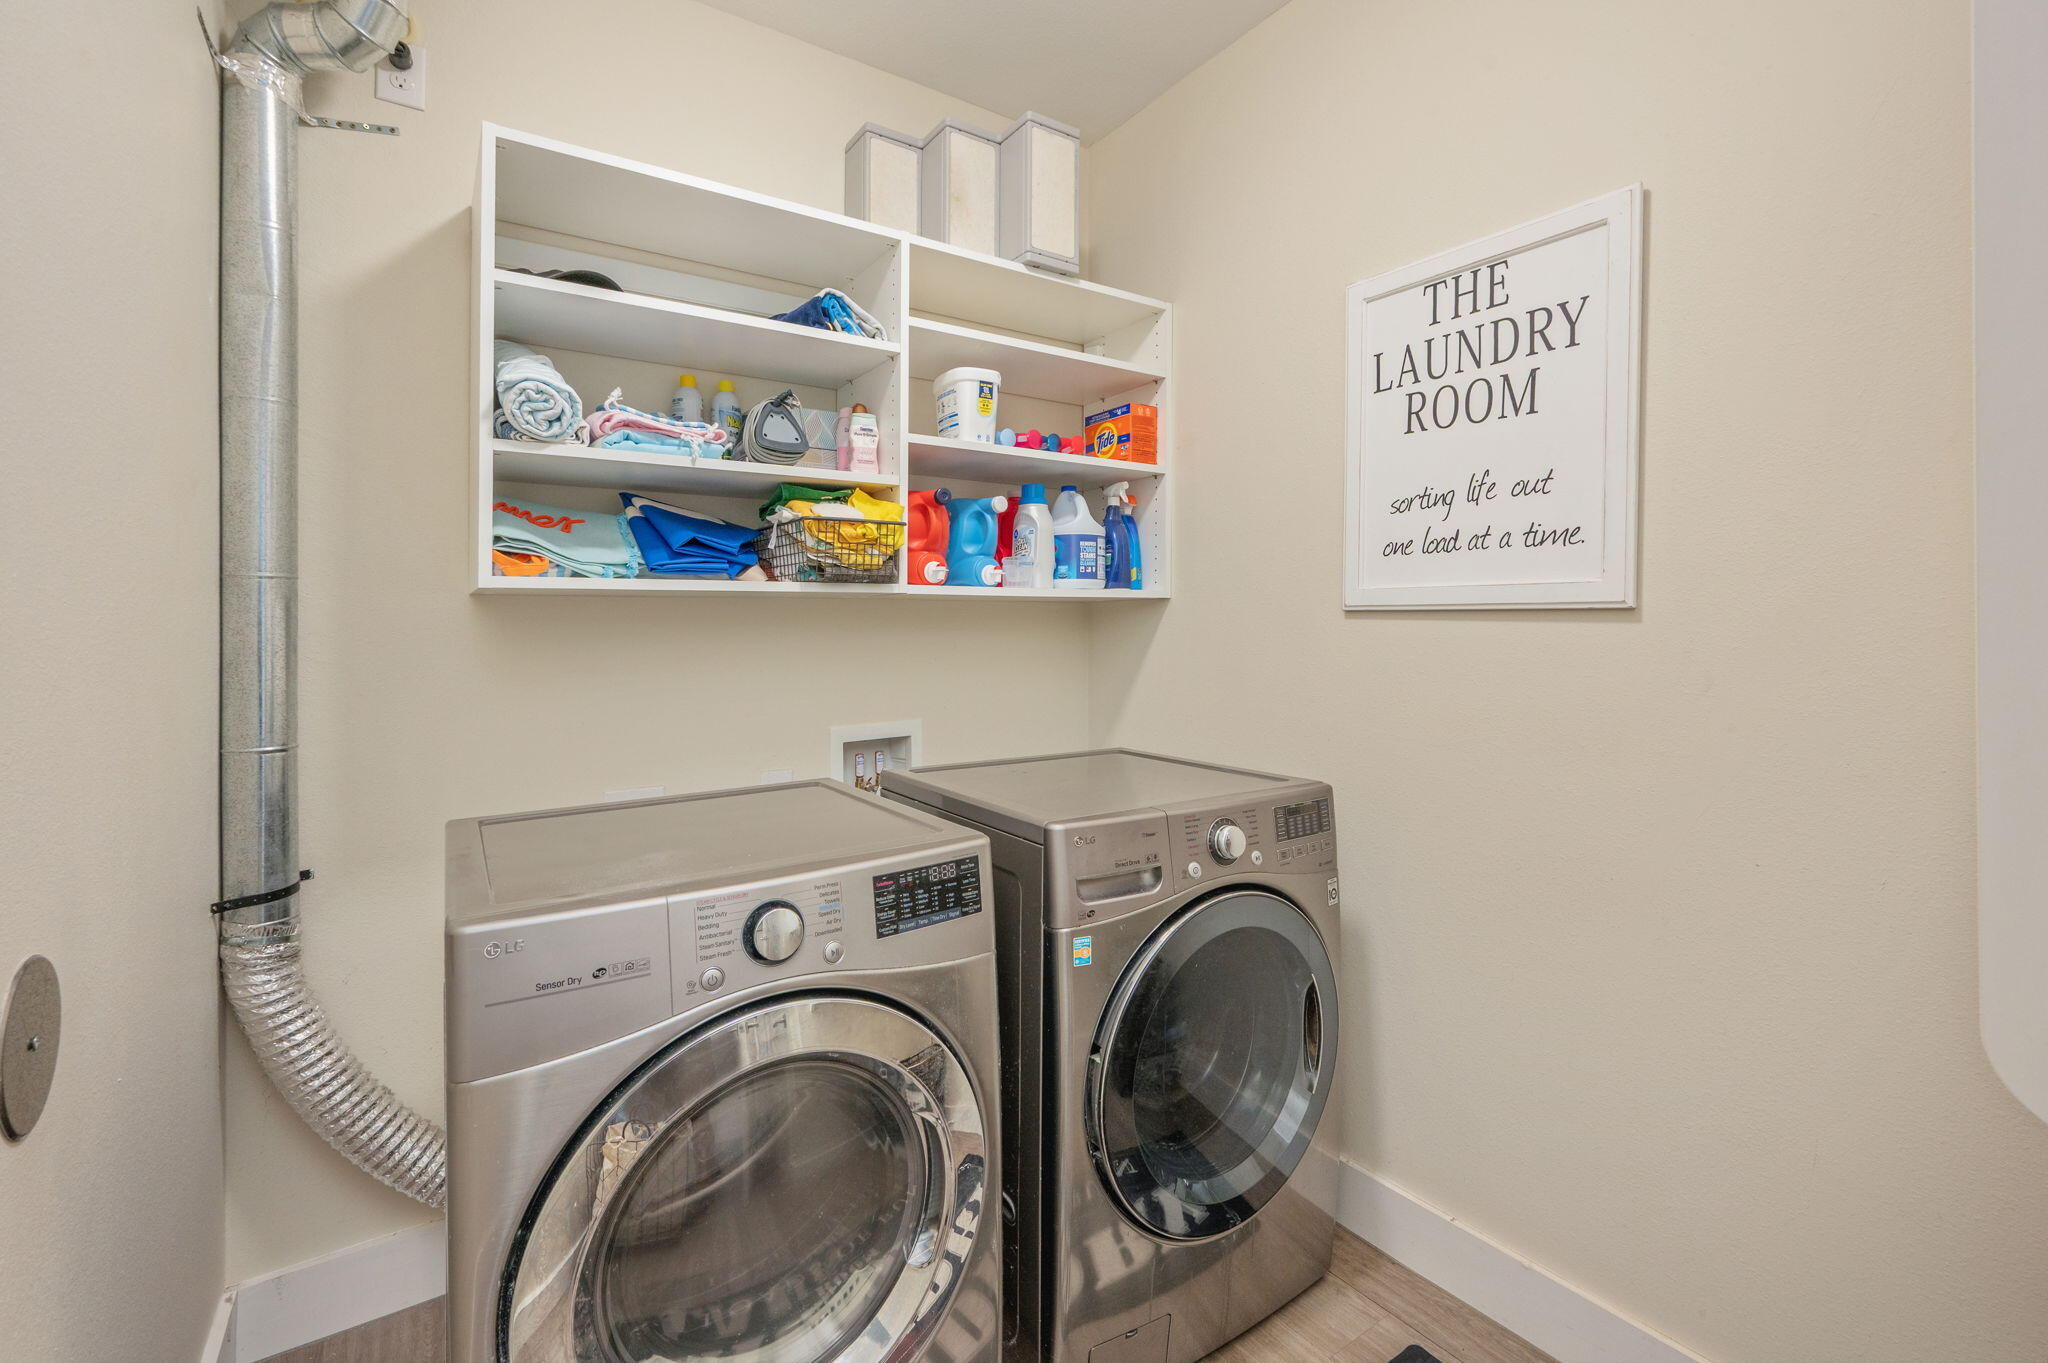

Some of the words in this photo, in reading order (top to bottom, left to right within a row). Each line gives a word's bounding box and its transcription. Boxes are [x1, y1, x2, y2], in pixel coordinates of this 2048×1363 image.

[1423, 260, 1510, 327] THE
[1373, 296, 1590, 394] LAUNDRY
[1403, 367, 1541, 435] ROOM
[1096, 431, 1115, 454] Tide
[1390, 486, 1455, 522] sorting
[1466, 468, 1497, 506] life
[1510, 468, 1554, 498] out
[1382, 539, 1414, 557] one
[1421, 526, 1462, 555] load
[1467, 525, 1492, 551] at
[1498, 531, 1513, 549] a
[1522, 521, 1585, 548] time.
[1085, 836, 1096, 845] LG
[698, 922, 720, 931] Bedding
[505, 939, 525, 955] LG
[535, 979, 565, 992] Sensor
[567, 976, 583, 987] Dry
